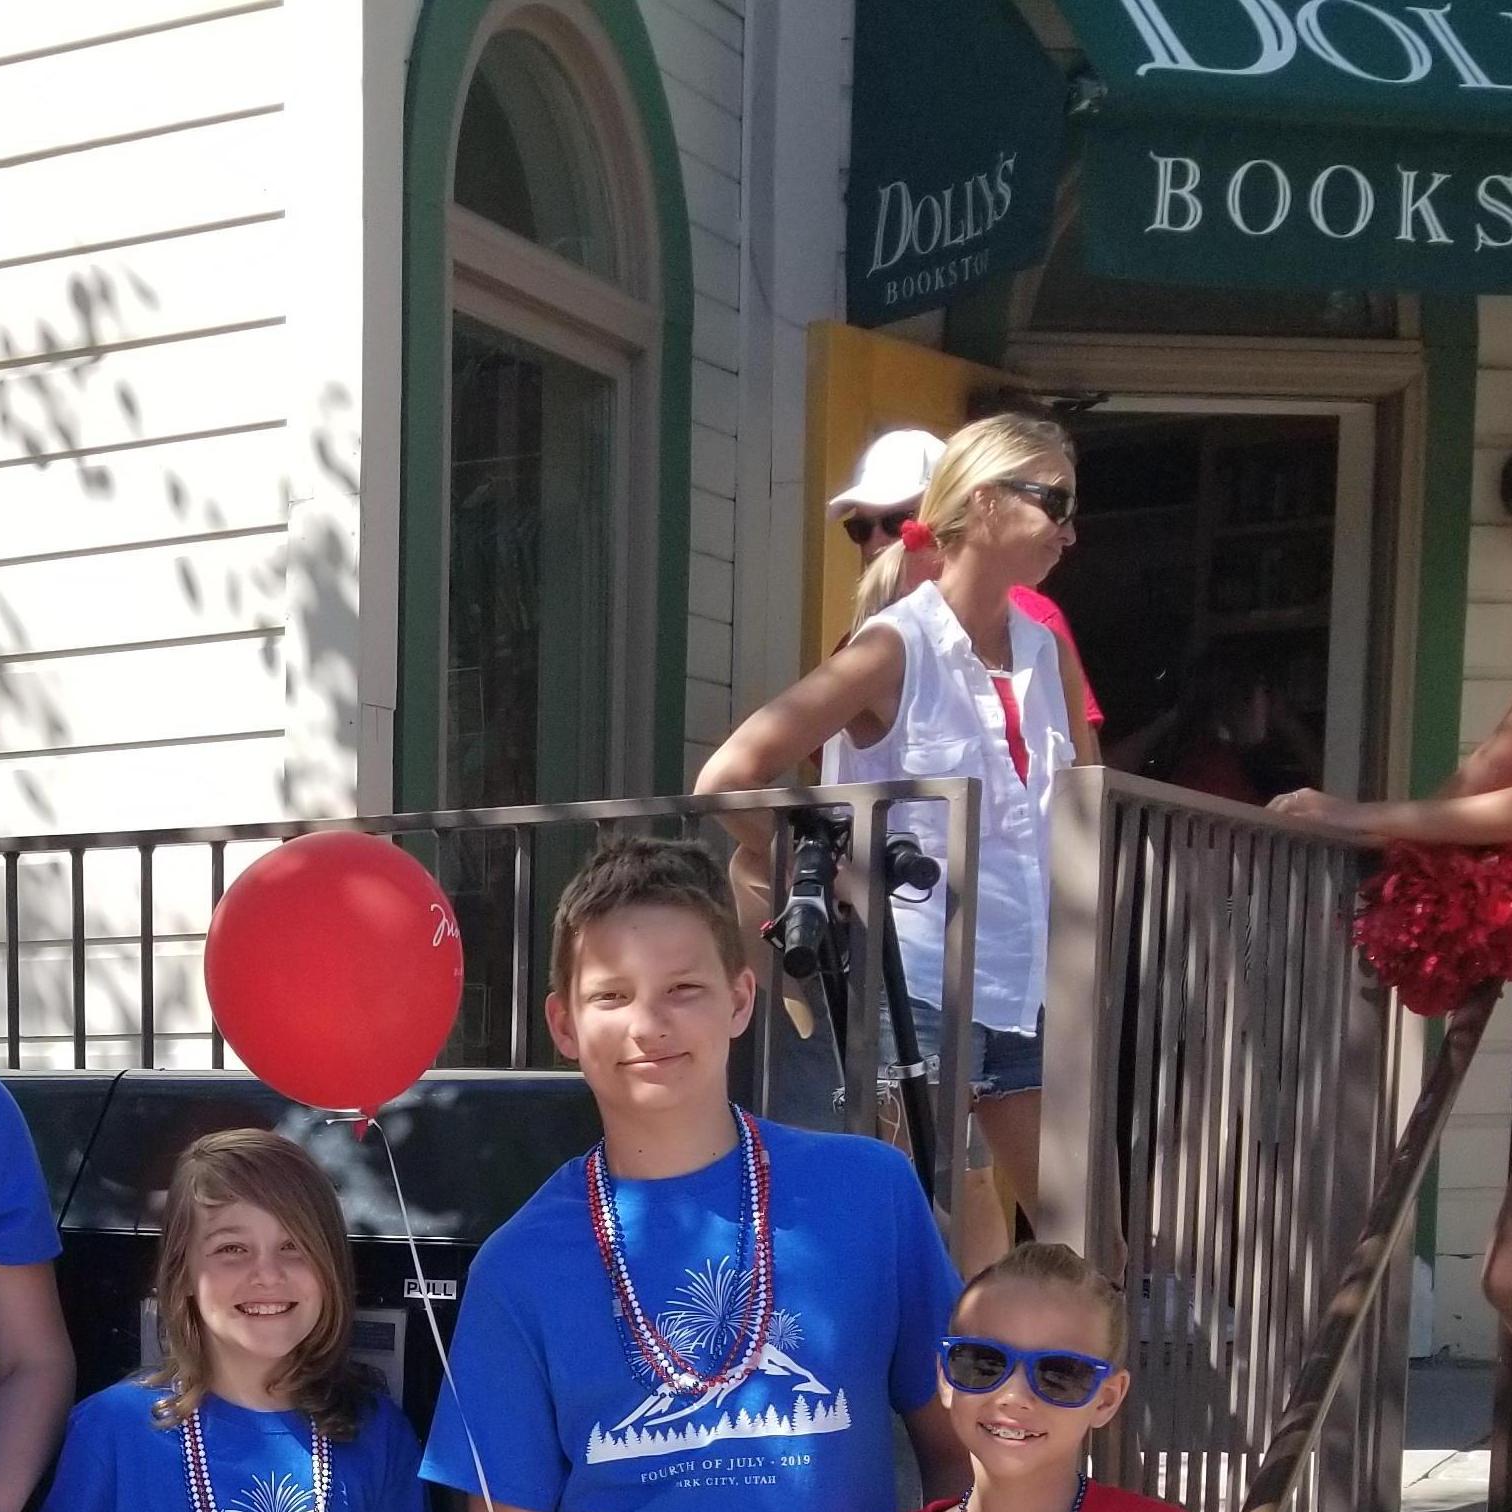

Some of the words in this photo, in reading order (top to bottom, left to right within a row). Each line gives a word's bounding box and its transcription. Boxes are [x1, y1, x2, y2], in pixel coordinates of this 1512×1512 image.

[1120, 0, 1512, 89] DOL
[1145, 150, 1512, 252] BOOKS
[640, 1460, 695, 1484] FOURTH
[702, 1458, 723, 1471] OF
[727, 1456, 765, 1471] JULY
[780, 1454, 811, 1467] 2019
[744, 1475, 777, 1486] UTAH
